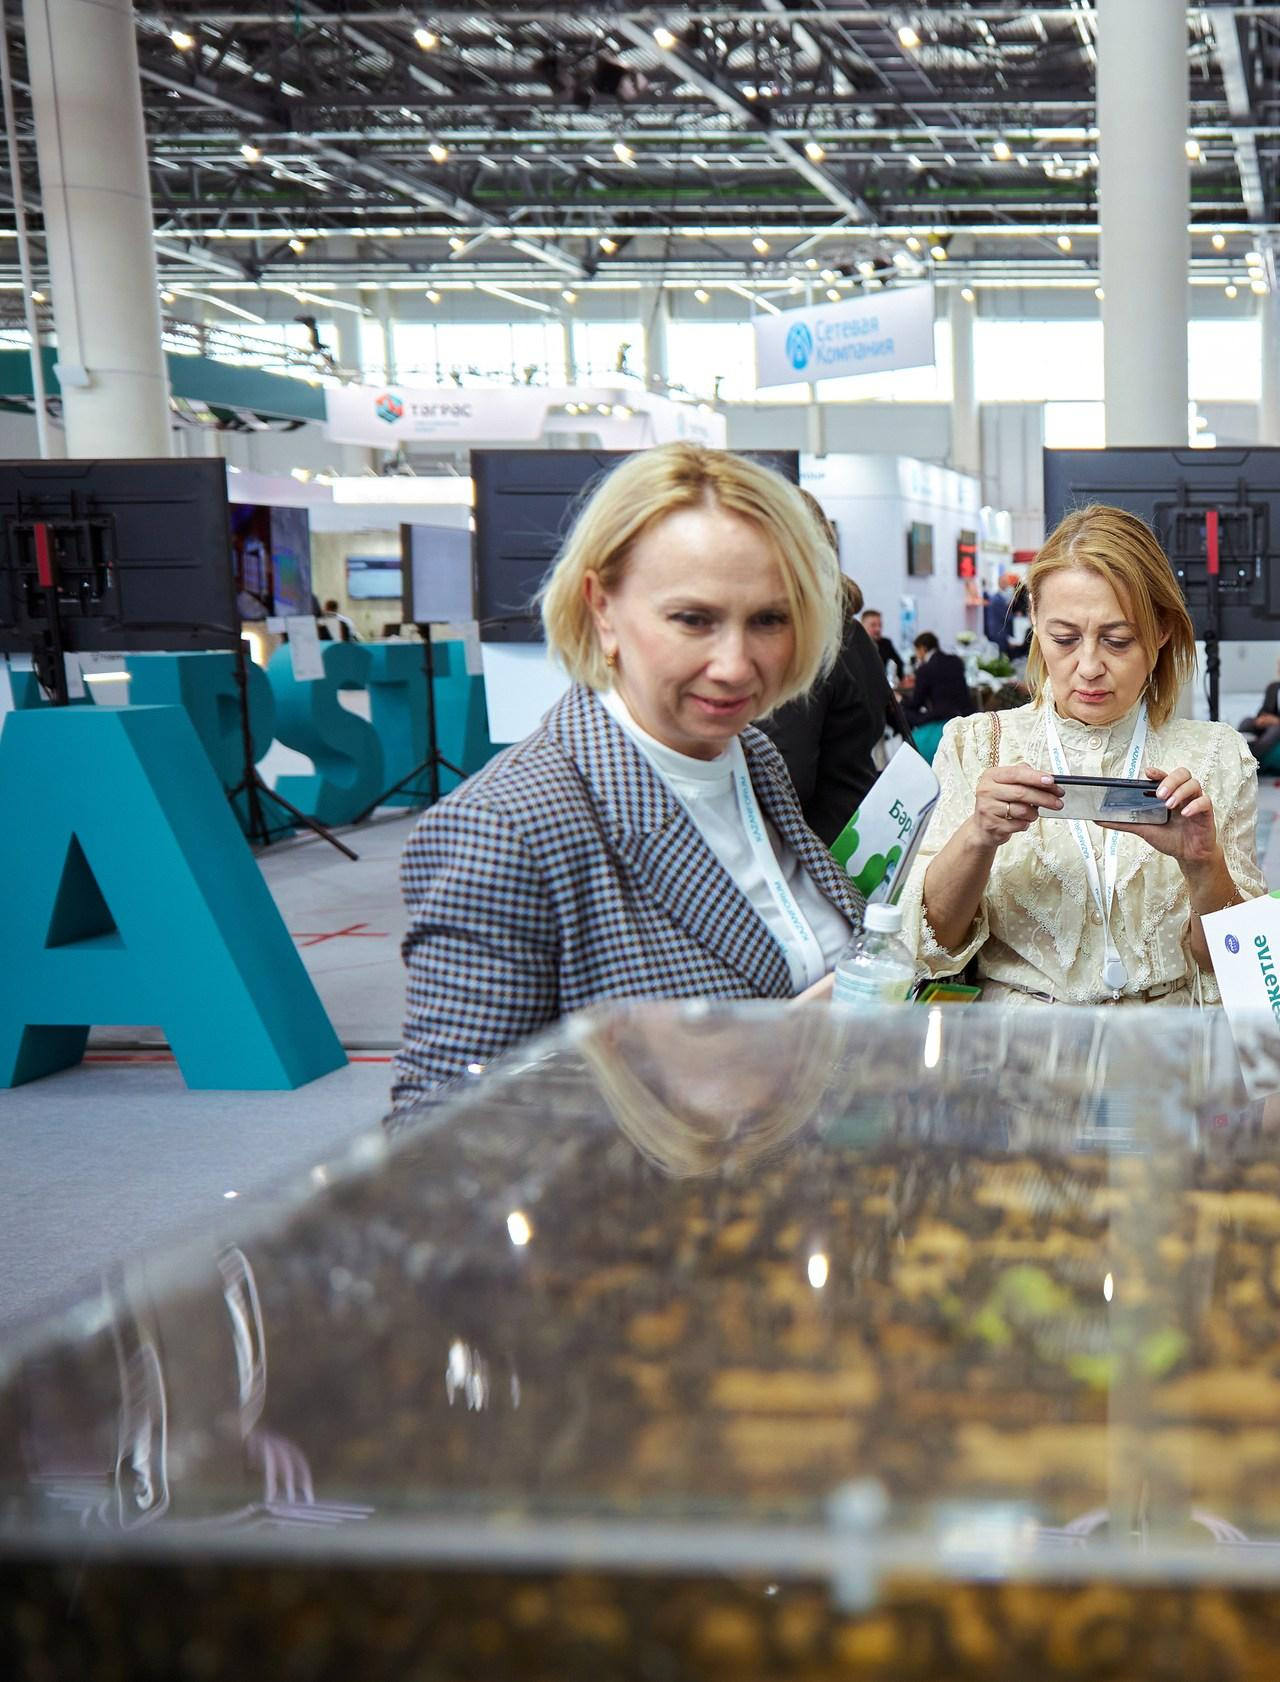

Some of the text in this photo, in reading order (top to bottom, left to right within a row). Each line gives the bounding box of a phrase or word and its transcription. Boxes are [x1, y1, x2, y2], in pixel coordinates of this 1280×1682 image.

[816, 316, 879, 342] Сетевая
[816, 337, 895, 365] Компания
[1127, 745, 1140, 780] KAZANFOR
[740, 775, 764, 843] KAZANFORUM
[774, 880, 809, 942] KAZANFORUM
